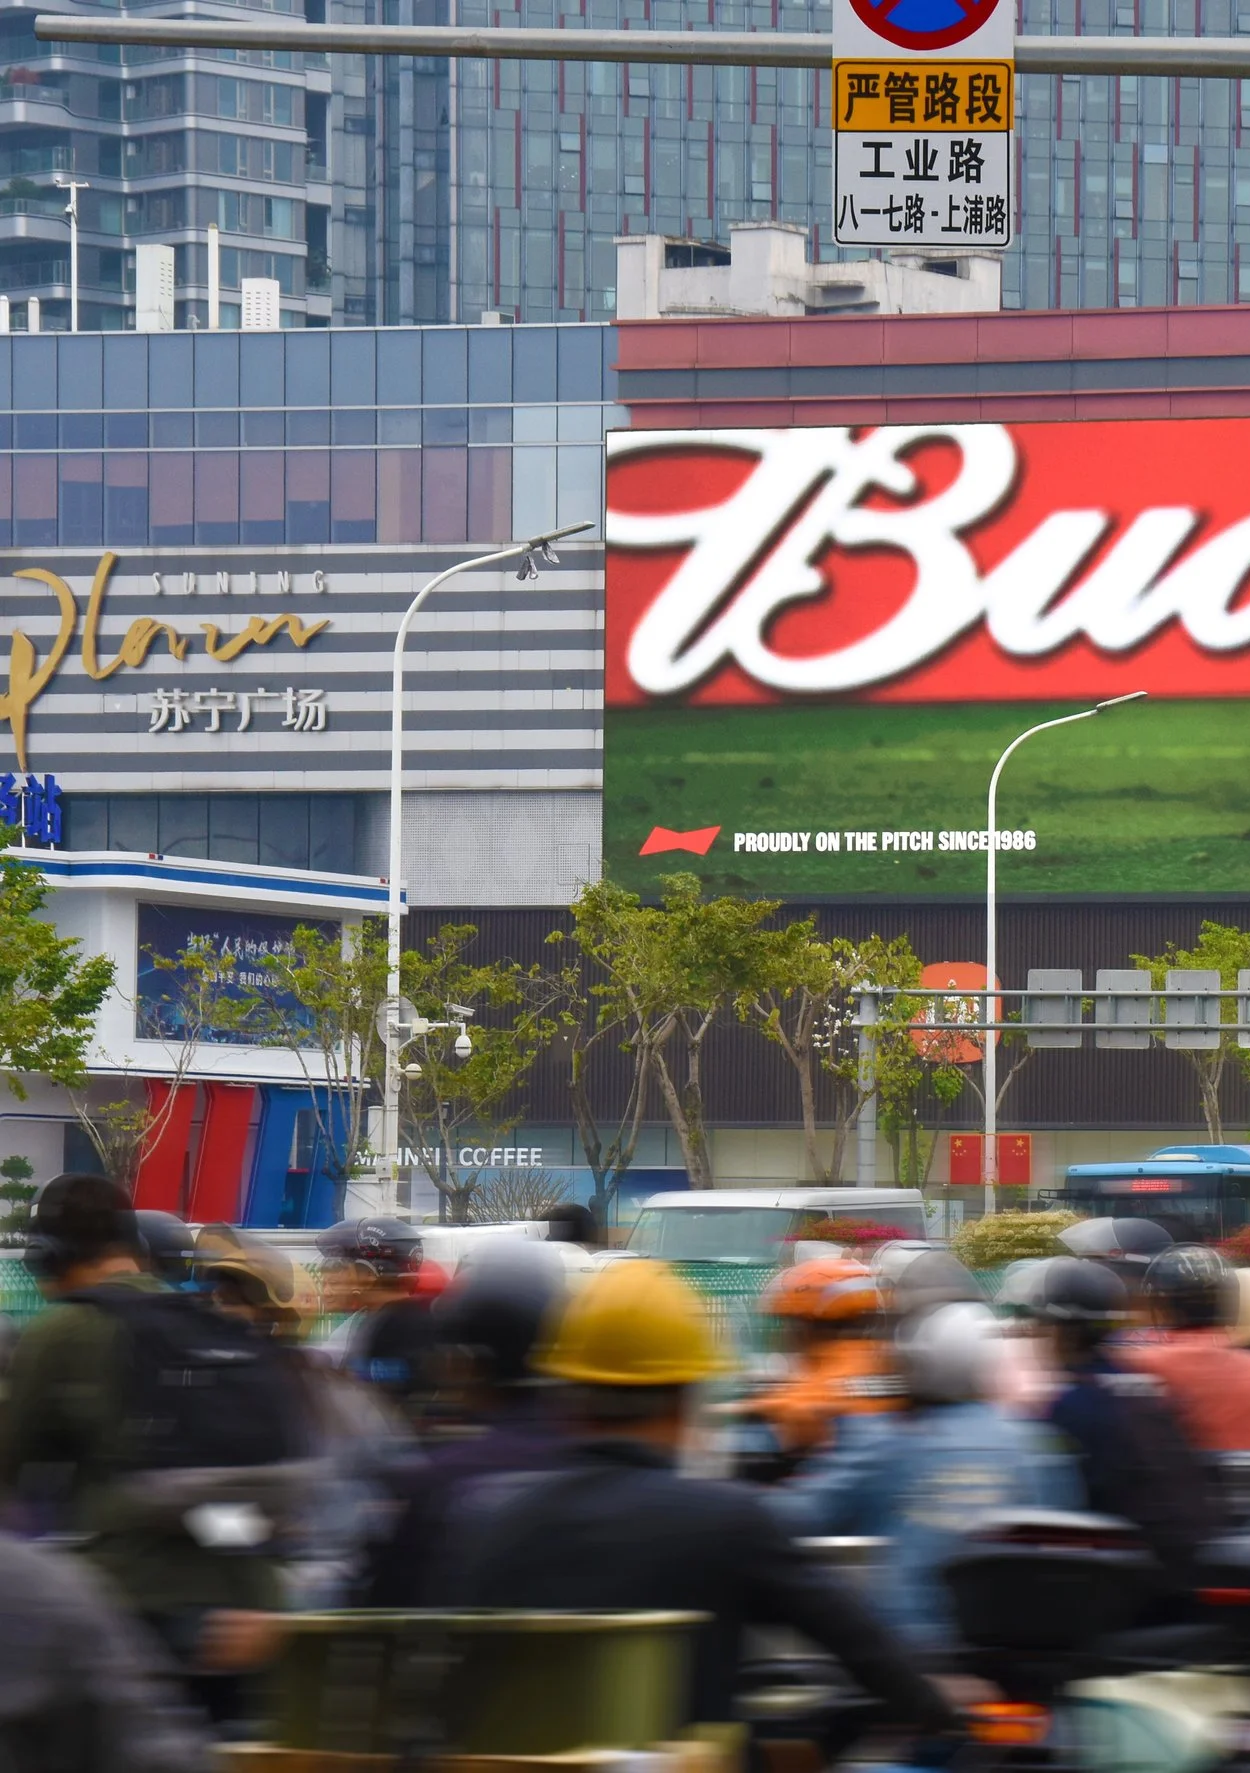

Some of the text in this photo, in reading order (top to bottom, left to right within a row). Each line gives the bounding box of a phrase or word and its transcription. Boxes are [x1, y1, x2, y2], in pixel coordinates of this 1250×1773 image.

[844, 71, 1002, 124] 严管路段
[860, 138, 985, 183] 工业路
[152, 571, 328, 594] SUNING
[149, 687, 329, 732] 苏宁广场
[734, 830, 1037, 852] PROUDLY ON THE PITCH SINCE 1986
[459, 1147, 543, 1167] COFFEE
